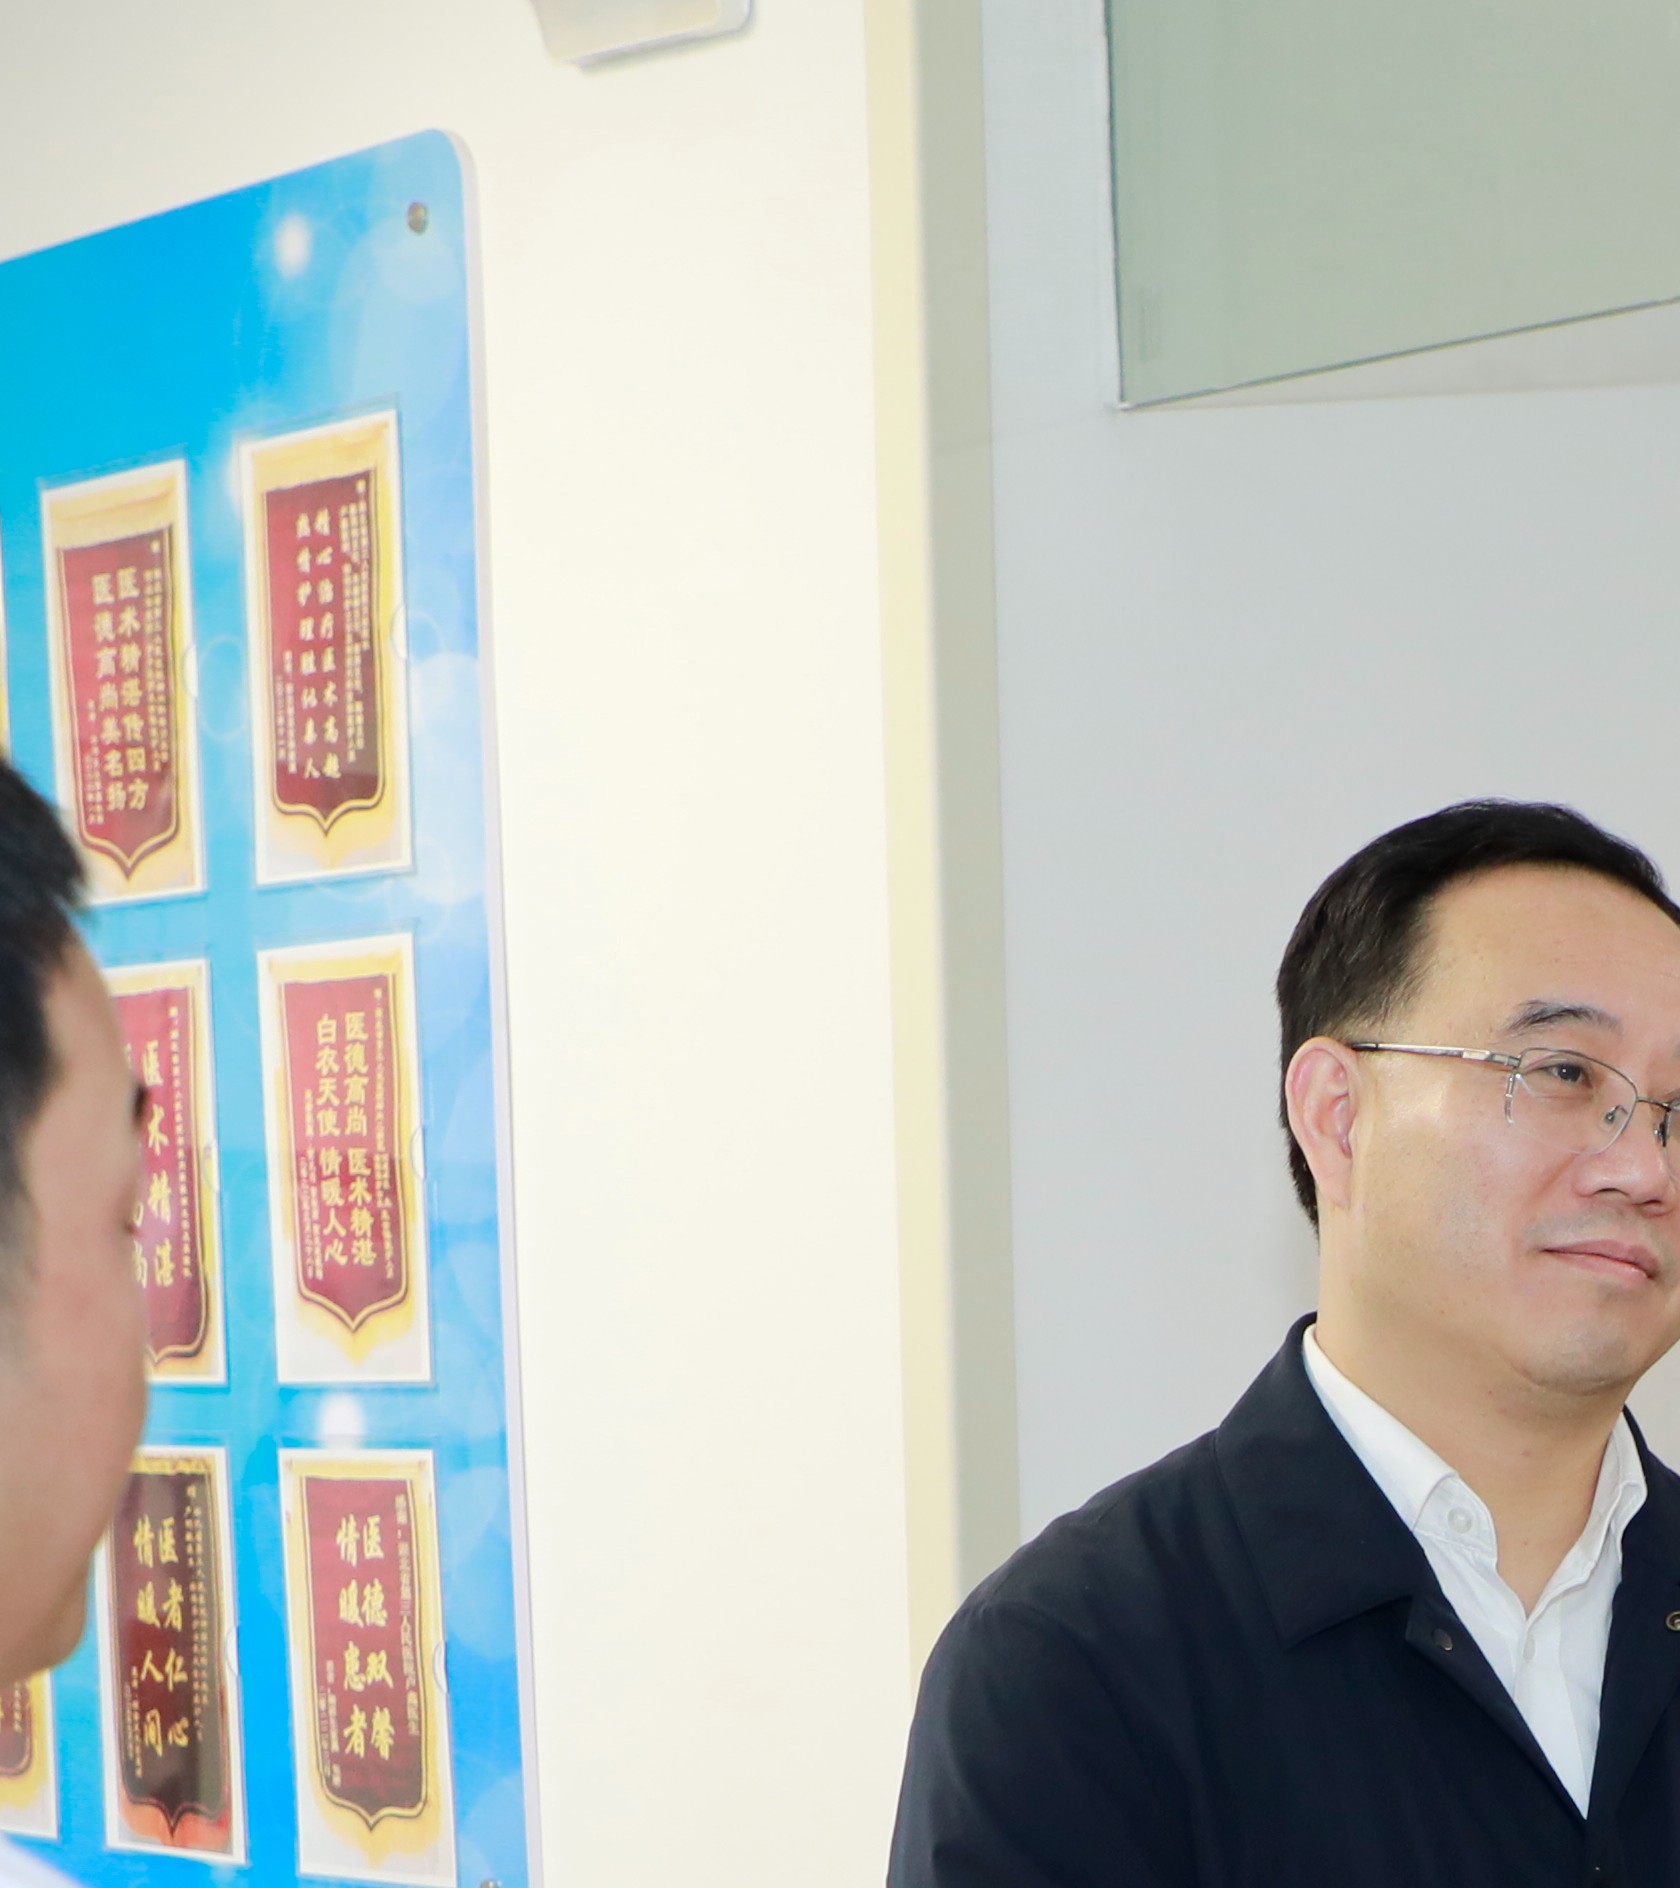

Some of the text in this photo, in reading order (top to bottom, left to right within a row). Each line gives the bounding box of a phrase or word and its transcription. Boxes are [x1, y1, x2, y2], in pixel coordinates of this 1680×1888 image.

[116, 566, 149, 811] 医术精湛传四方
[142, 1040, 174, 1288] 医术精湛
[132, 1513, 165, 1757] 情暖人间
[158, 1516, 191, 1748] 医者仁心
[336, 1513, 367, 1760] 情暖患者
[361, 1515, 397, 1761] 医德双馨
